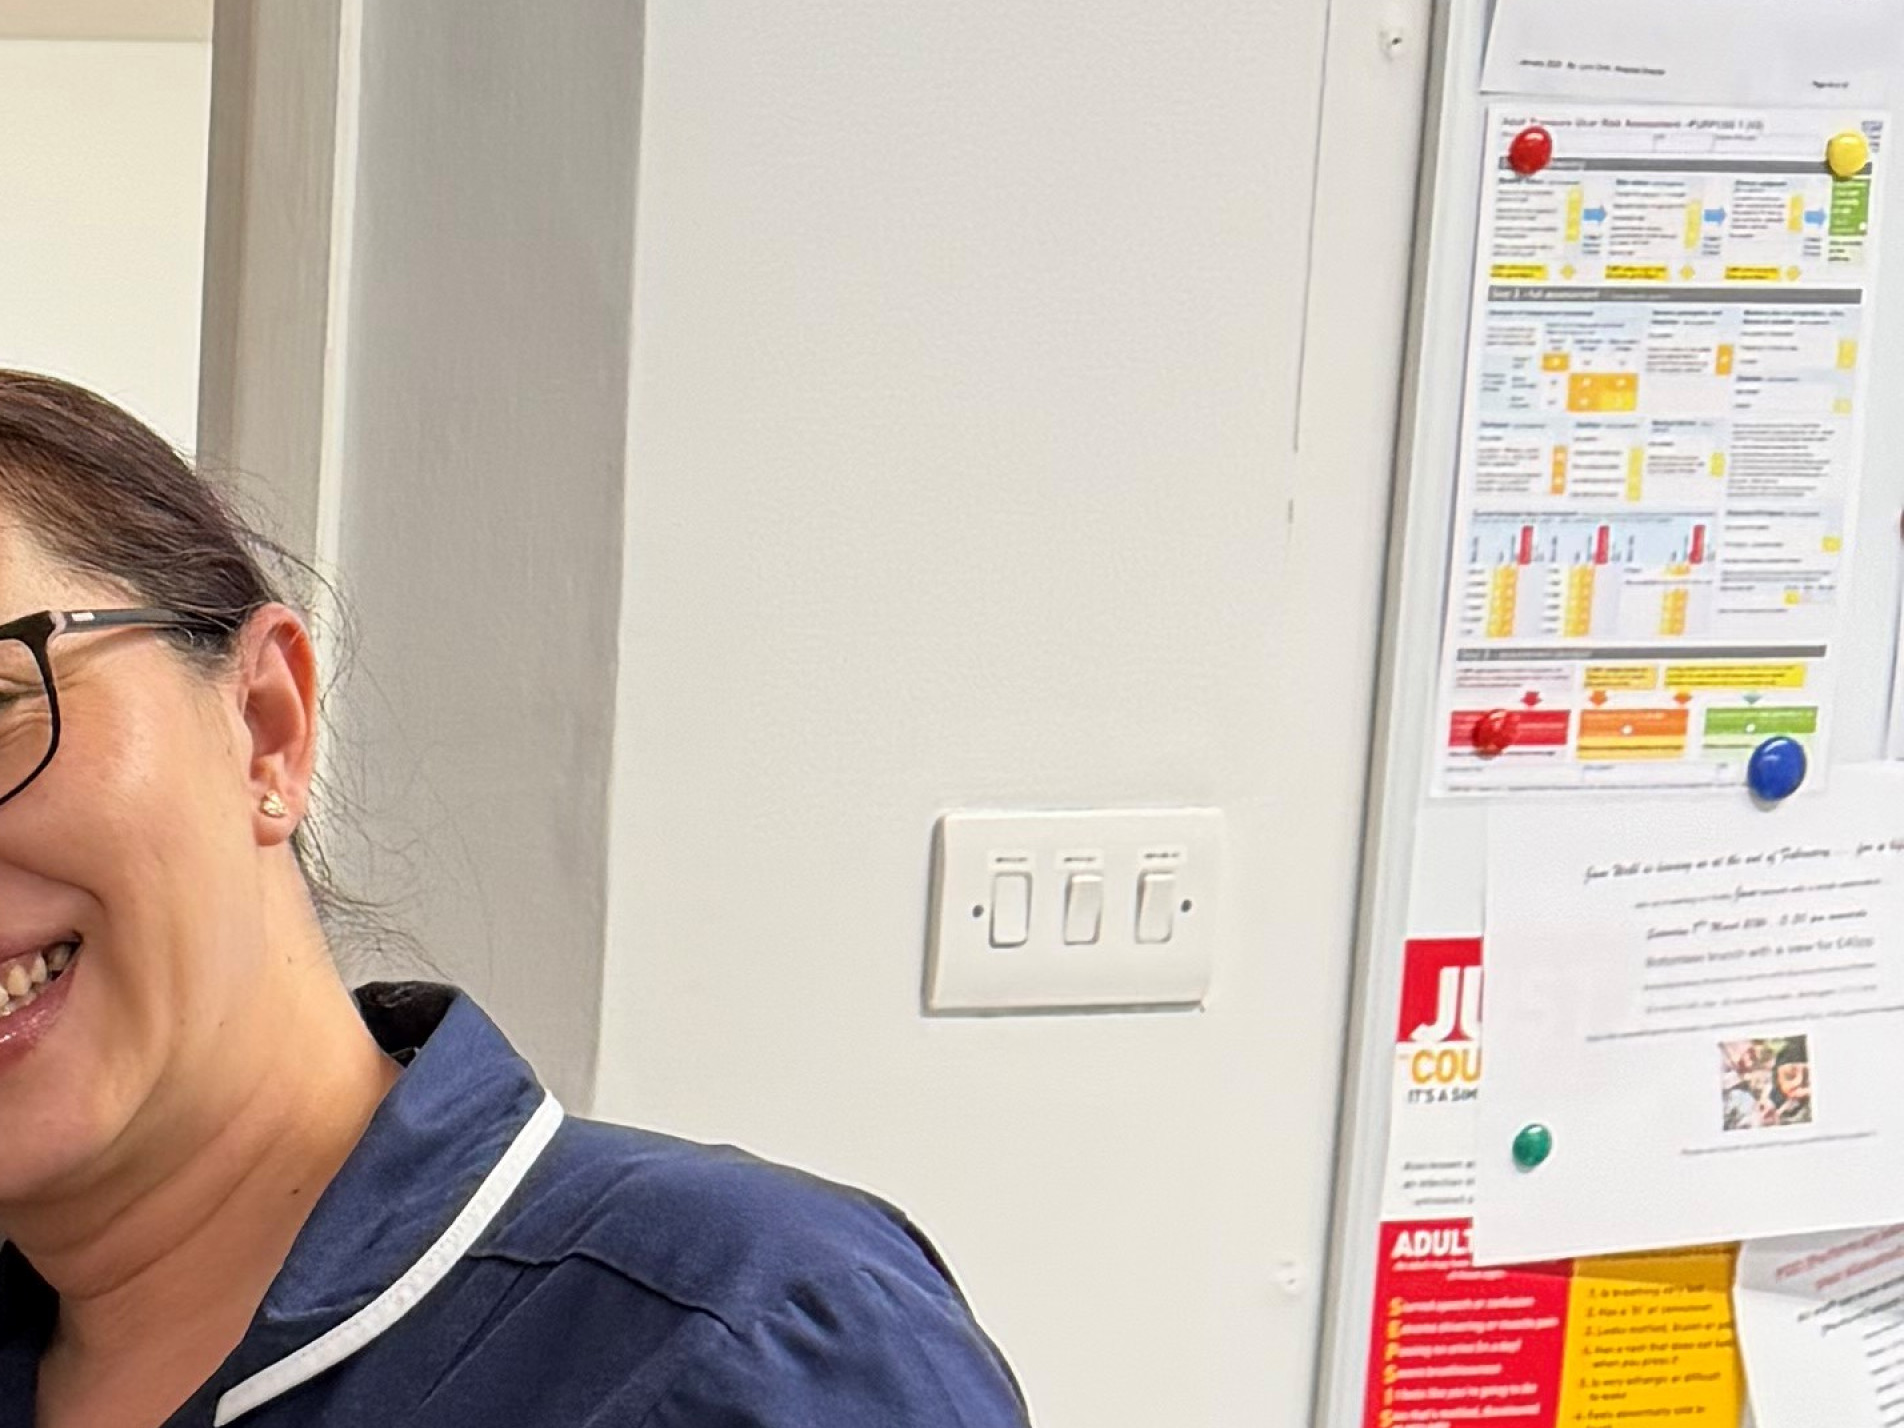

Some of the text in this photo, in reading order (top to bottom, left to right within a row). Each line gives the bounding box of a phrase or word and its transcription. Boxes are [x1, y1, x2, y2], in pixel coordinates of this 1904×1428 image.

[1411, 1048, 1482, 1085] COU
[1408, 1088, 1434, 1104] IT'S
[1438, 1089, 1449, 1103] A
